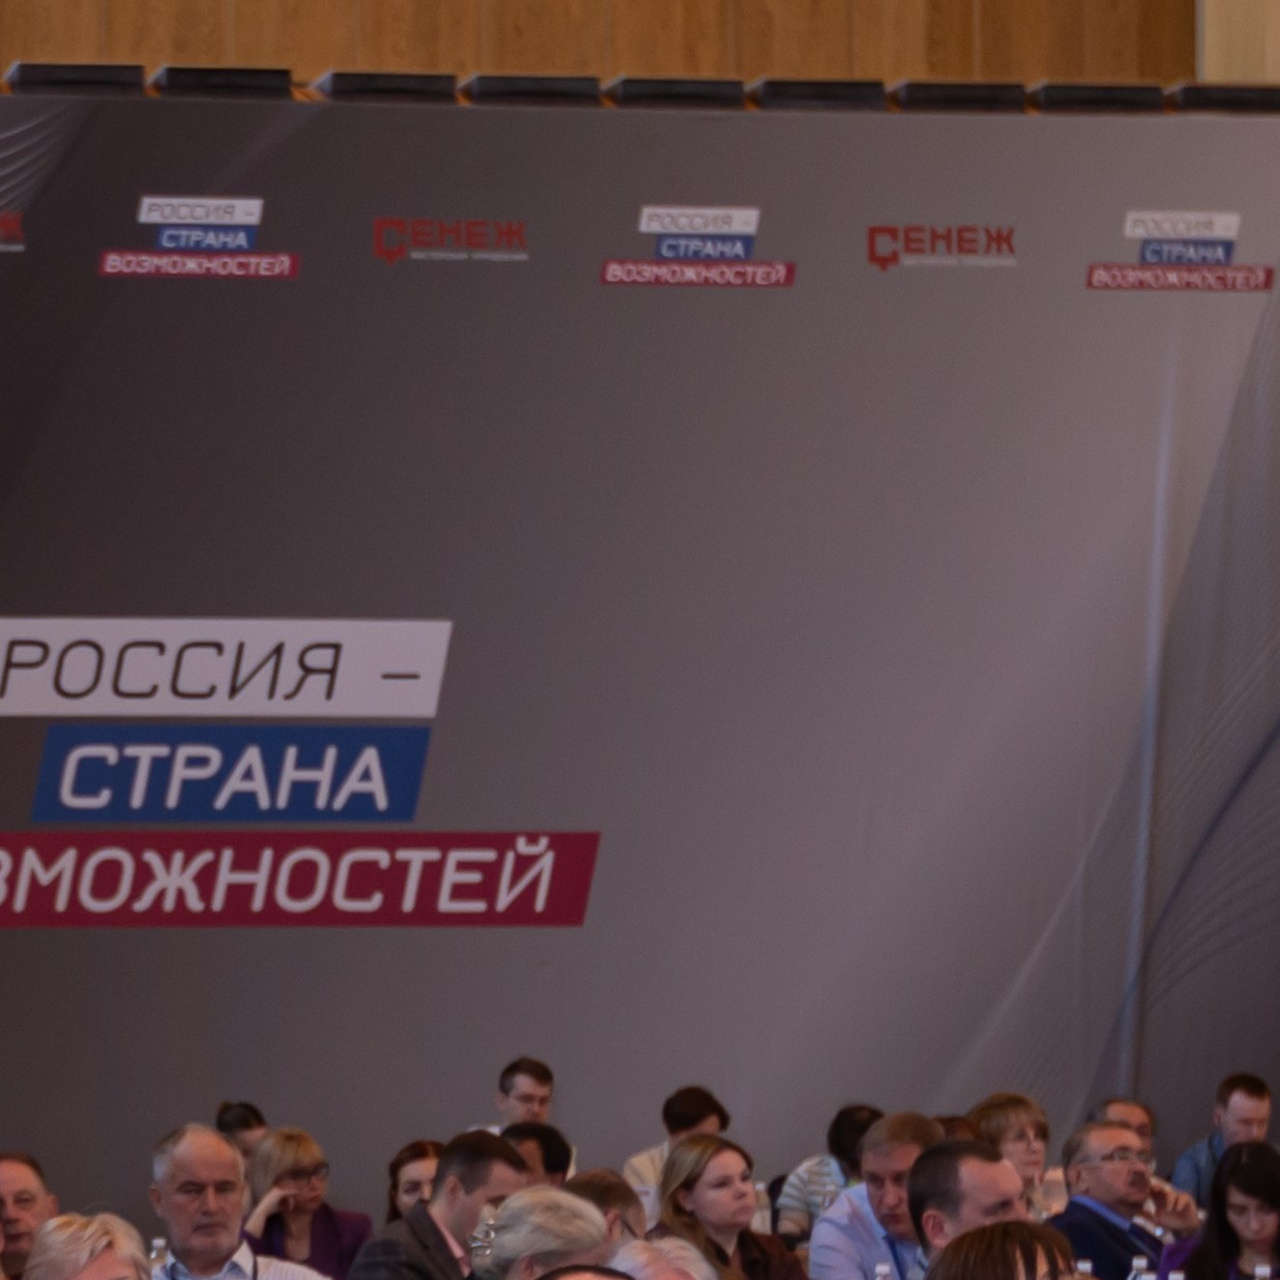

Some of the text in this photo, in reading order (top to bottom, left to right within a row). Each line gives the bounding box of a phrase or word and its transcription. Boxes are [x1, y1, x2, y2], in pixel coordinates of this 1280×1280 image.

[146, 203, 236, 221] РОССИЯ
[647, 213, 734, 230] РОССИЯ
[161, 229, 249, 249] СТРАНА
[373, 218, 527, 267] СЕНЕЖ
[660, 239, 746, 259] СТРАНА
[866, 225, 1015, 272] СЕНЕЖ
[1143, 241, 1225, 263] СТРАНА
[104, 253, 291, 276] ВОЗМОЖНОСТЕЙ
[606, 261, 787, 285] ВОЗМОЖНОСТЕЙ
[59, 745, 390, 811] СТРАНА
